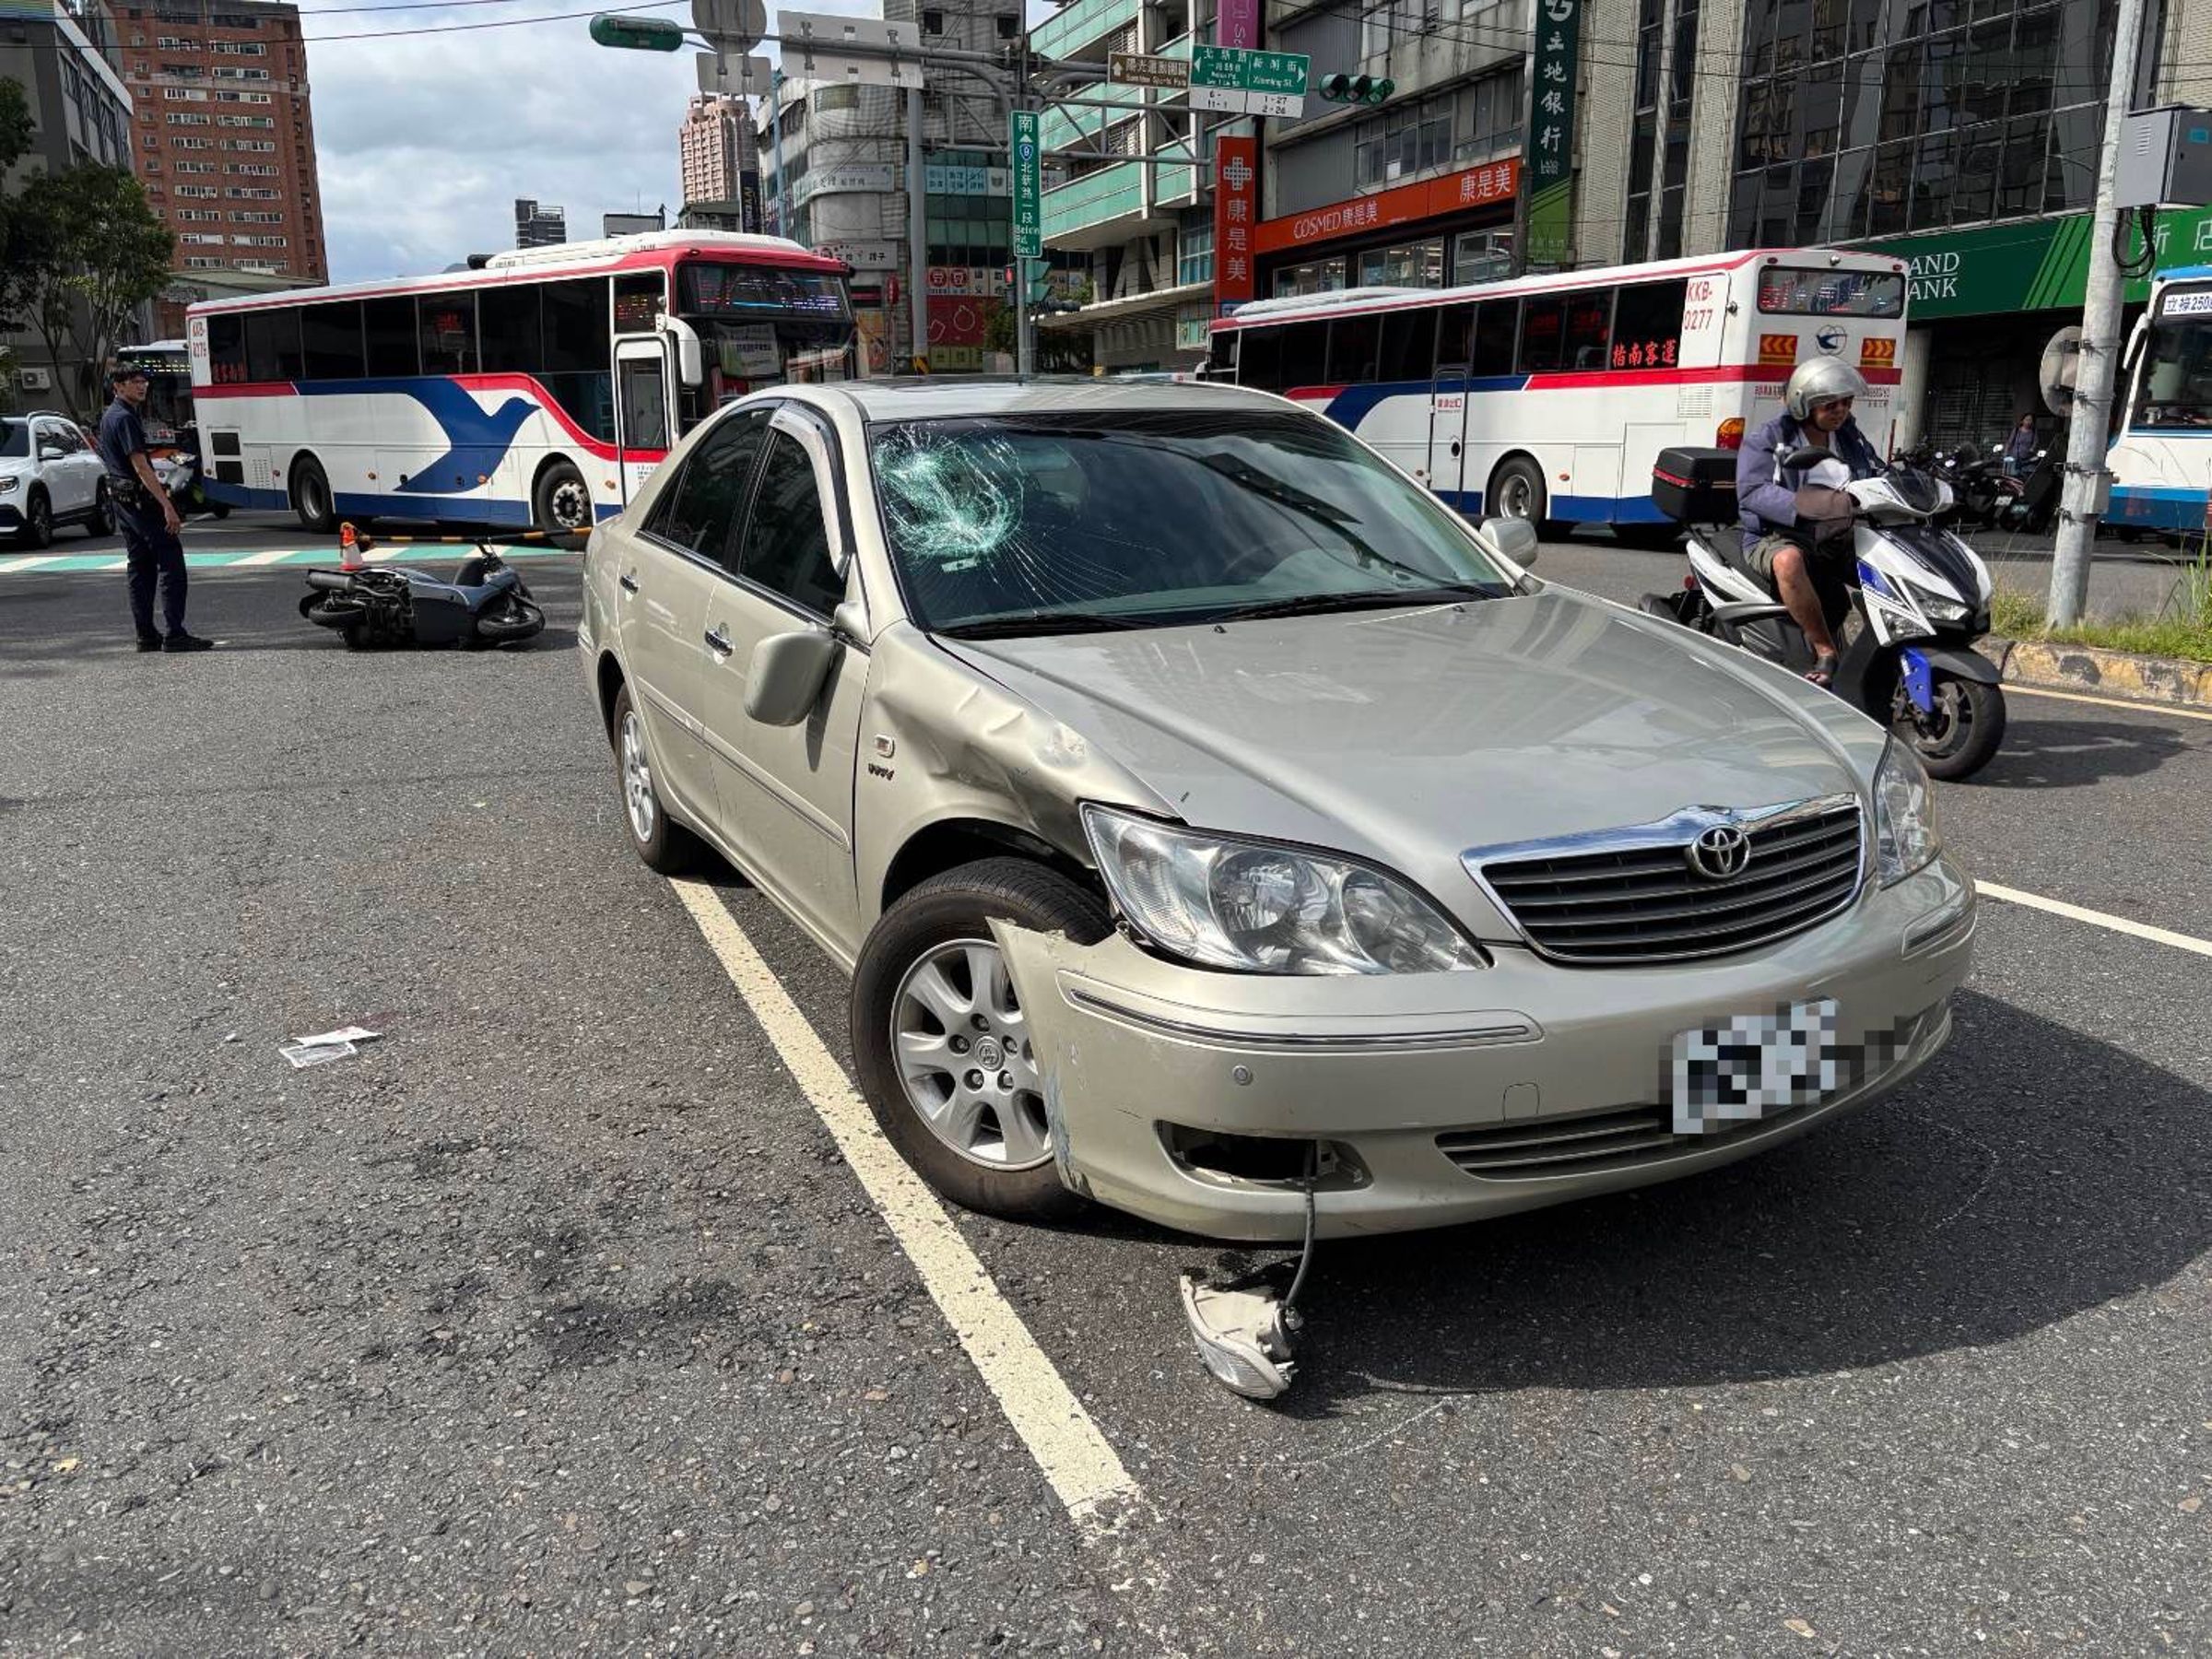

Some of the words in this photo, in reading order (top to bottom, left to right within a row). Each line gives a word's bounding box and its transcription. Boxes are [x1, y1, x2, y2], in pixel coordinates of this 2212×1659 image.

[1018, 115, 1033, 133] 南
[1460, 164, 1512, 203] 康是美
[1293, 212, 1340, 240] COSMED
[1342, 200, 1378, 228] 康是美
[1227, 198, 1247, 281] 康是美
[1908, 252, 1960, 276] AND
[1908, 277, 1959, 300] ANK
[1684, 309, 1713, 331] 0277
[1612, 338, 1677, 367] 指南客運
